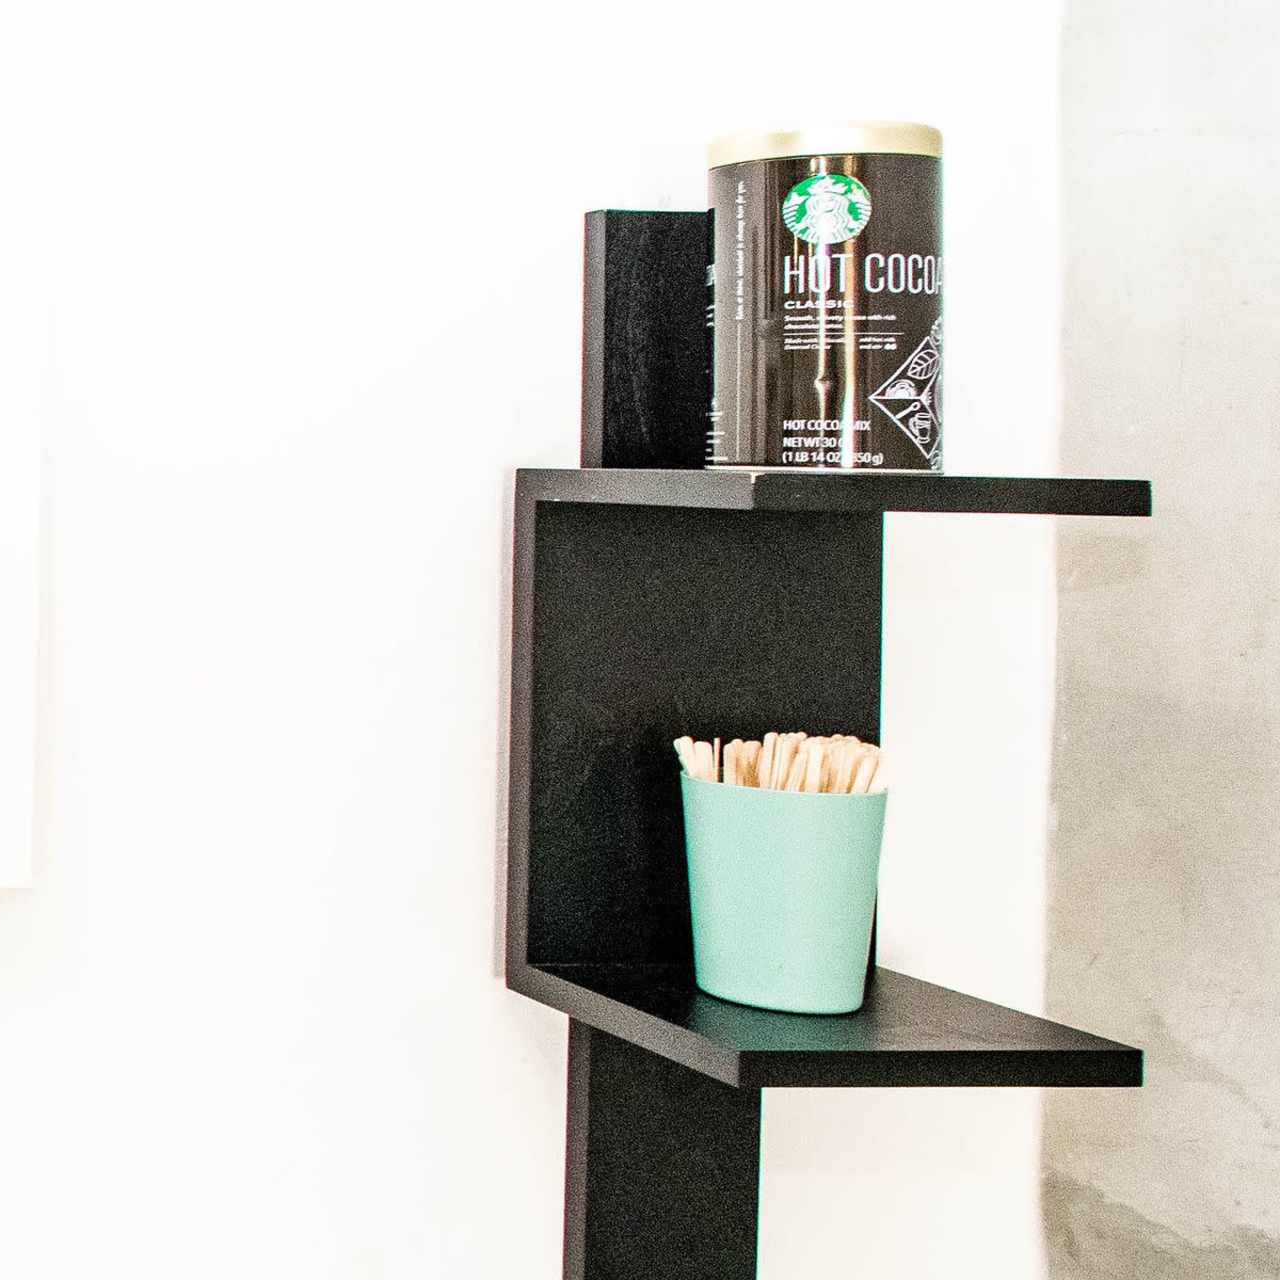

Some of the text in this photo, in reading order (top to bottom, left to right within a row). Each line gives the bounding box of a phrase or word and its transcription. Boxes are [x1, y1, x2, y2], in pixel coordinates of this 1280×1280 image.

[783, 253, 855, 294] HOT
[783, 299, 855, 309] CLASSIC
[783, 419, 807, 431] HOT
[806, 419, 844, 431] COCO
[783, 437, 836, 448] NET WT 30
[795, 452, 810, 463] LB
[811, 452, 825, 463] 14
